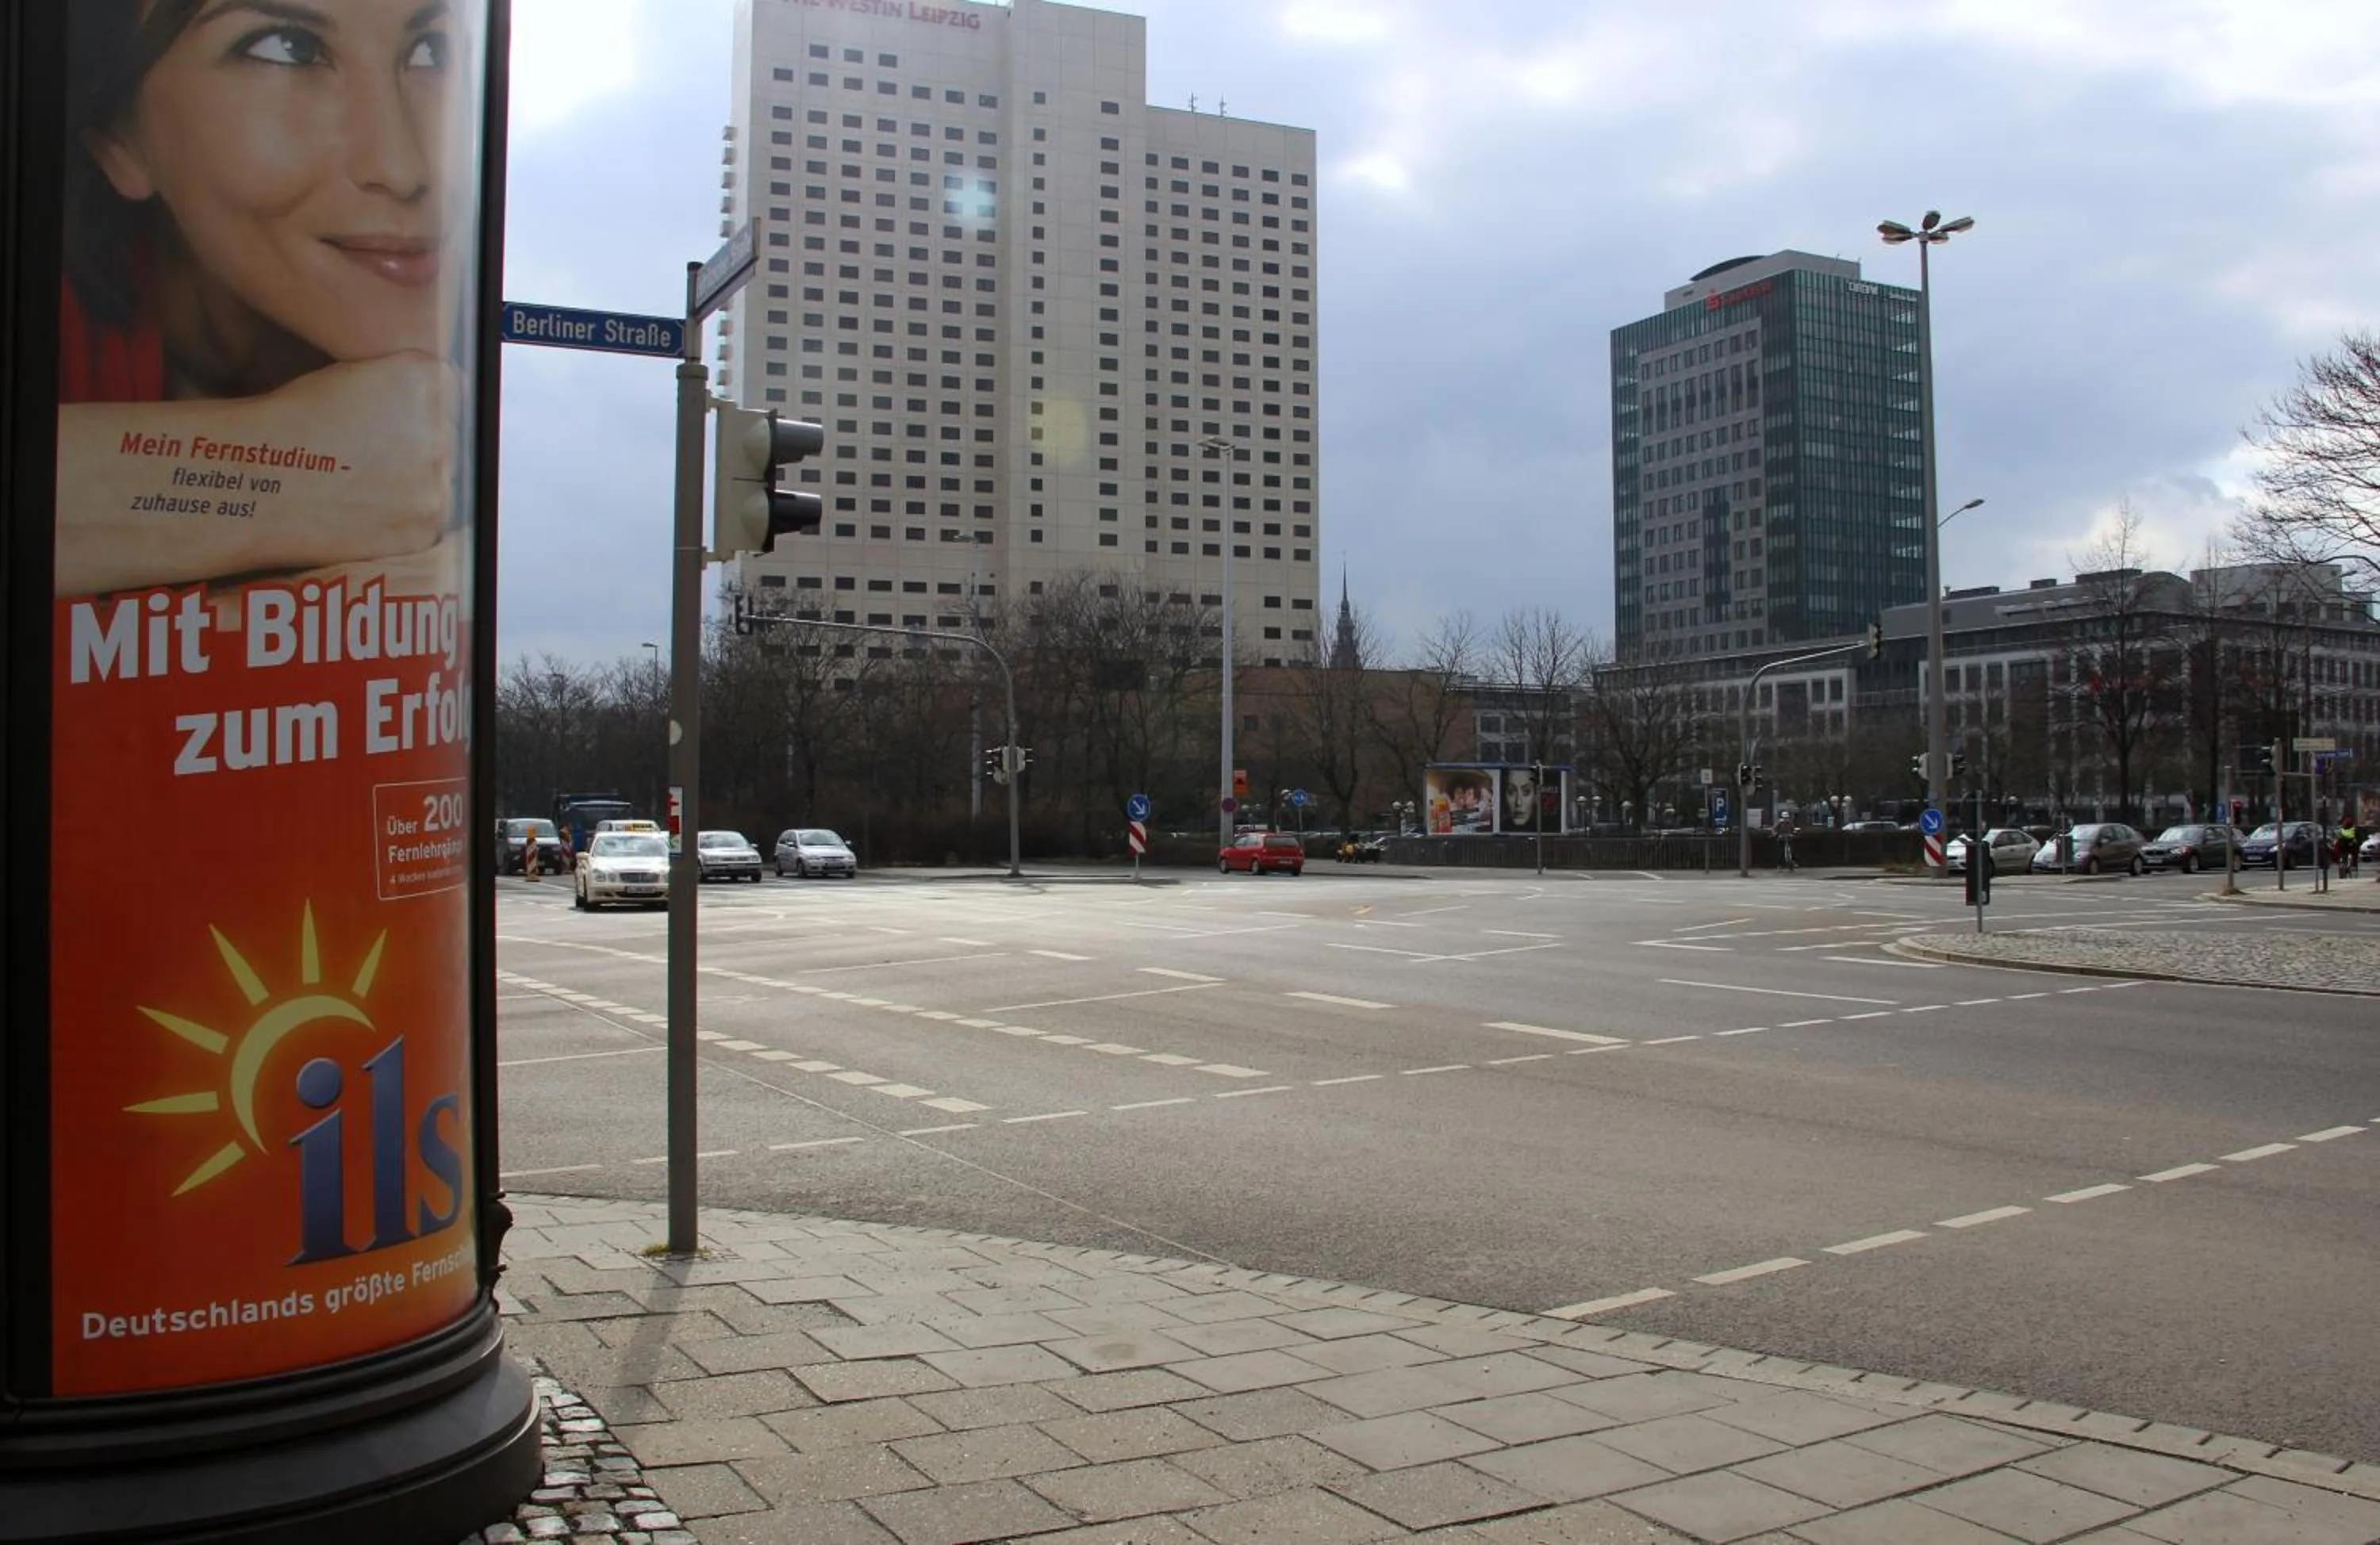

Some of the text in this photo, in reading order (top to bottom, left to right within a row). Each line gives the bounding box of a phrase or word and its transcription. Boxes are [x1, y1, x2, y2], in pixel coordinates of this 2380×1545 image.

[908, 1, 981, 29] LEIPZIG
[512, 311, 671, 347] Berliner Straße
[121, 431, 182, 458] Mein
[190, 436, 336, 473] Fernstudium
[171, 466, 281, 493] flexibel von
[130, 493, 256, 517] zuhause aus!
[71, 583, 458, 684] Mit Bildung
[174, 699, 338, 776] zum
[424, 793, 463, 832] 200
[1716, 797, 1725, 812] P
[284, 1033, 463, 1267] ils
[82, 1290, 315, 1340] Deutschlands
[325, 1271, 405, 1313] größte
